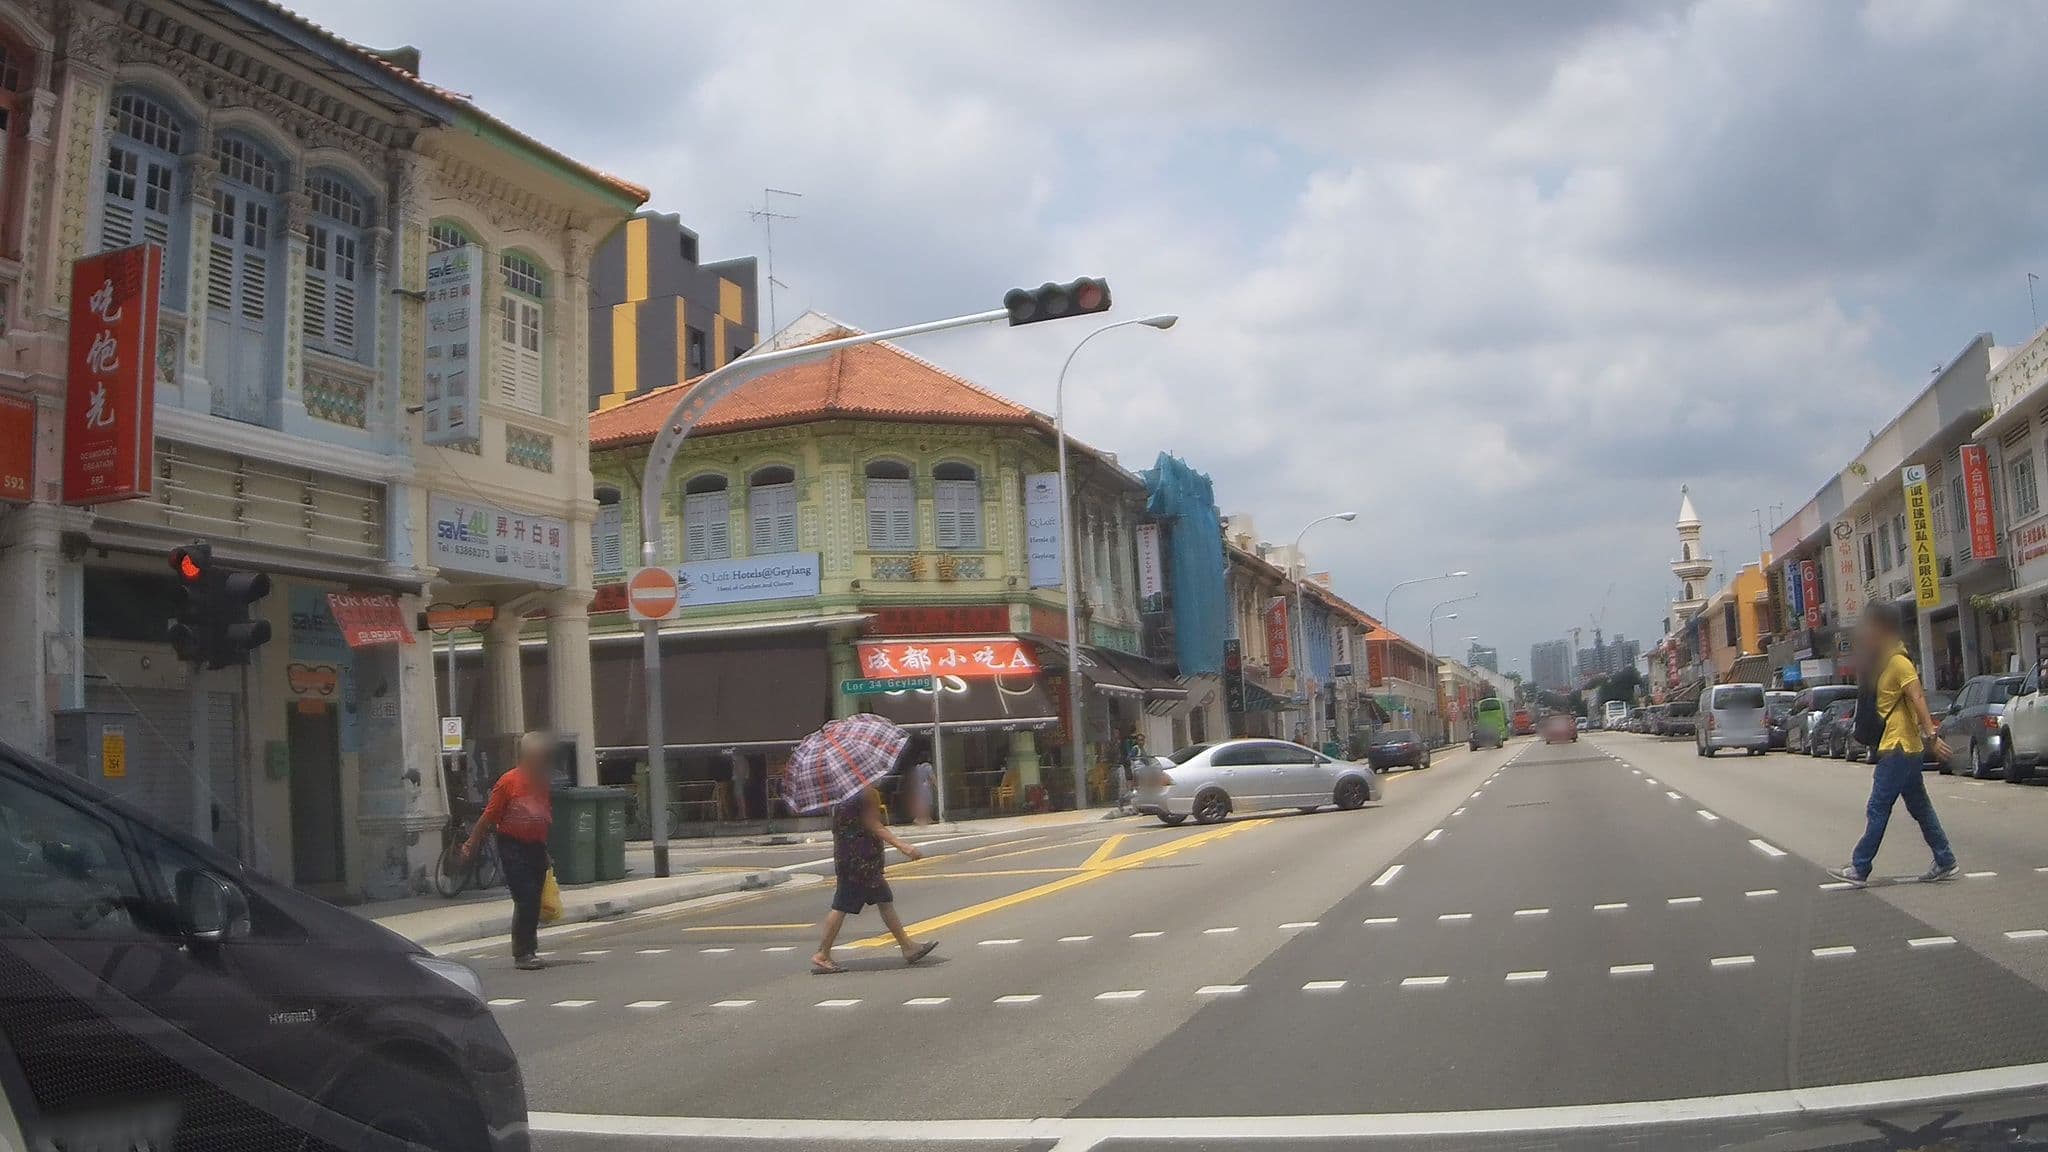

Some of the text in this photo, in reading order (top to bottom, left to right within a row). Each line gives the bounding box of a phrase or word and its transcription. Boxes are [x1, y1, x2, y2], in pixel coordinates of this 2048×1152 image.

[4, 475, 24, 489] 592
[700, 572, 712, 584] Q
[712, 570, 729, 582] Loft
[1804, 566, 1818, 620] 615
[846, 681, 863, 691] Lor
[869, 680, 881, 689] 34
[887, 678, 930, 689] Geylang
